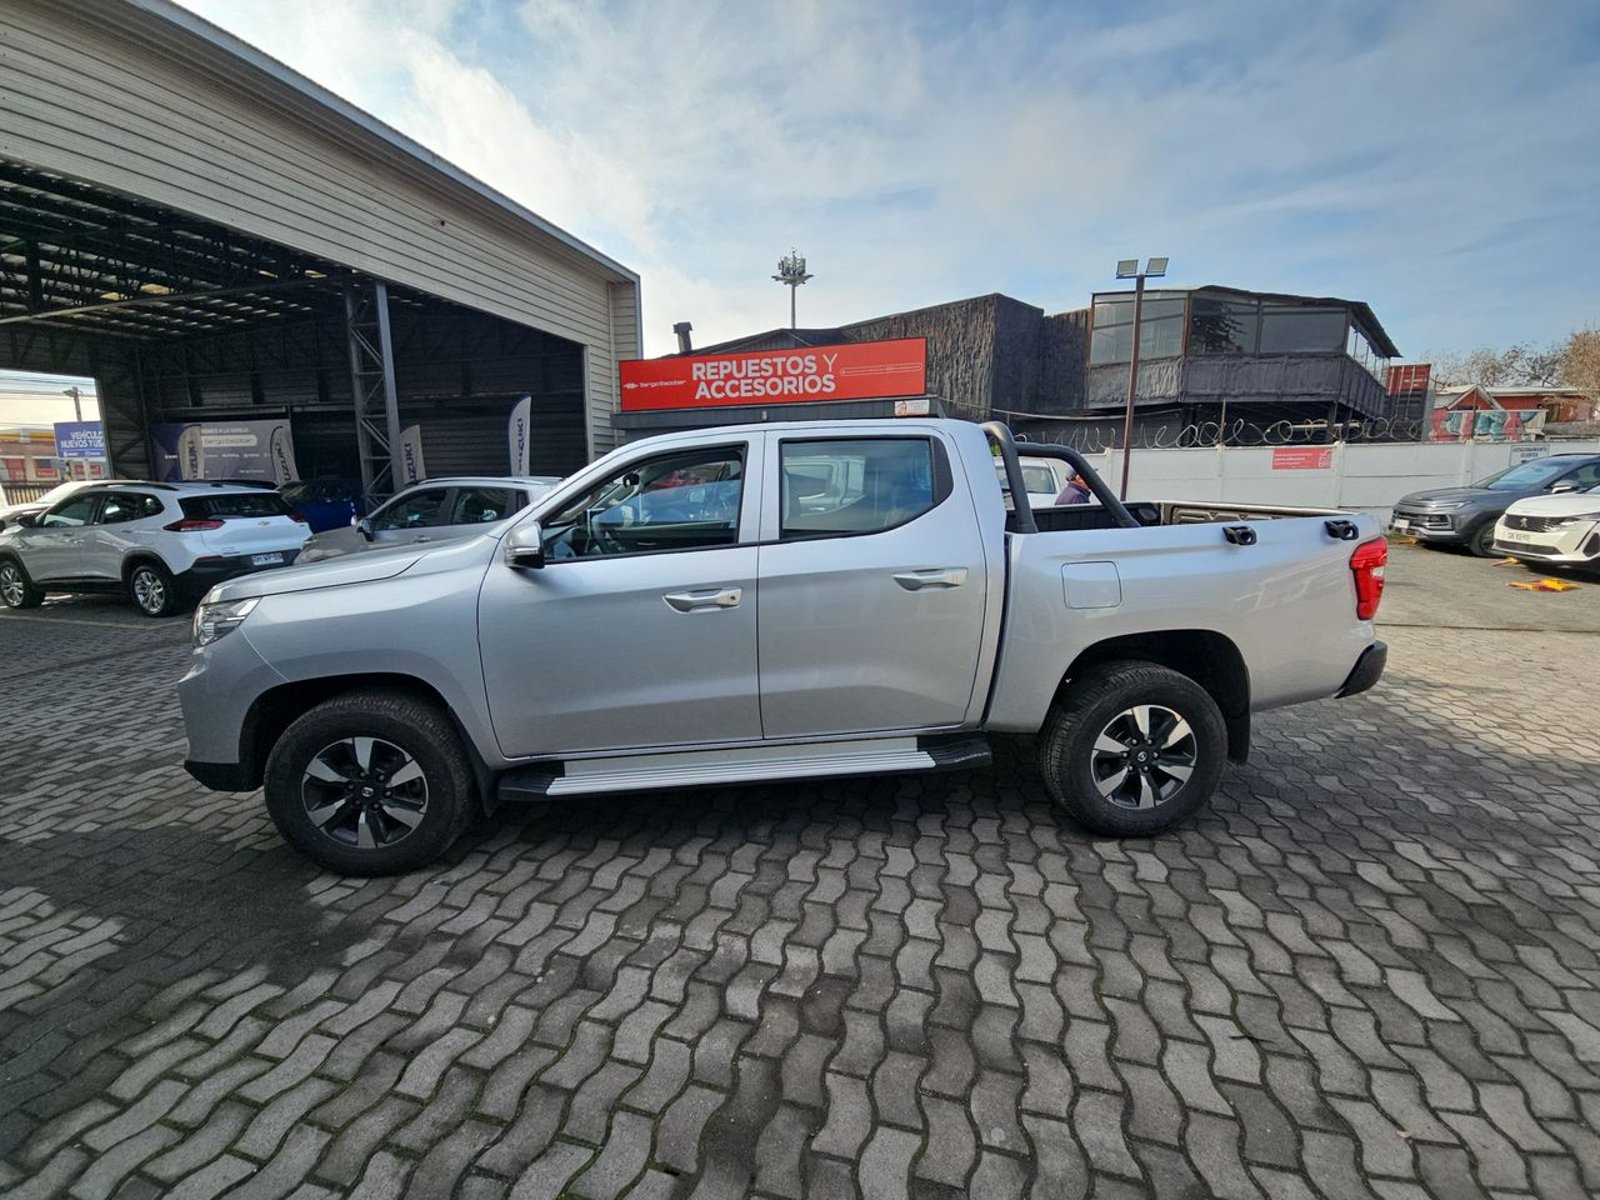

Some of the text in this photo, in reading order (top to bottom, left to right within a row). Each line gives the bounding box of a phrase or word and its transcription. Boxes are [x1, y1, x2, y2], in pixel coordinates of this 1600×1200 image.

[692, 354, 817, 381] REPUESTOS
[822, 353, 838, 373] Y
[694, 374, 836, 400] ACCESORIOS
[70, 429, 104, 440] VEHÍCULO
[275, 441, 292, 481] UZUKI
[404, 443, 416, 480] UZUKI
